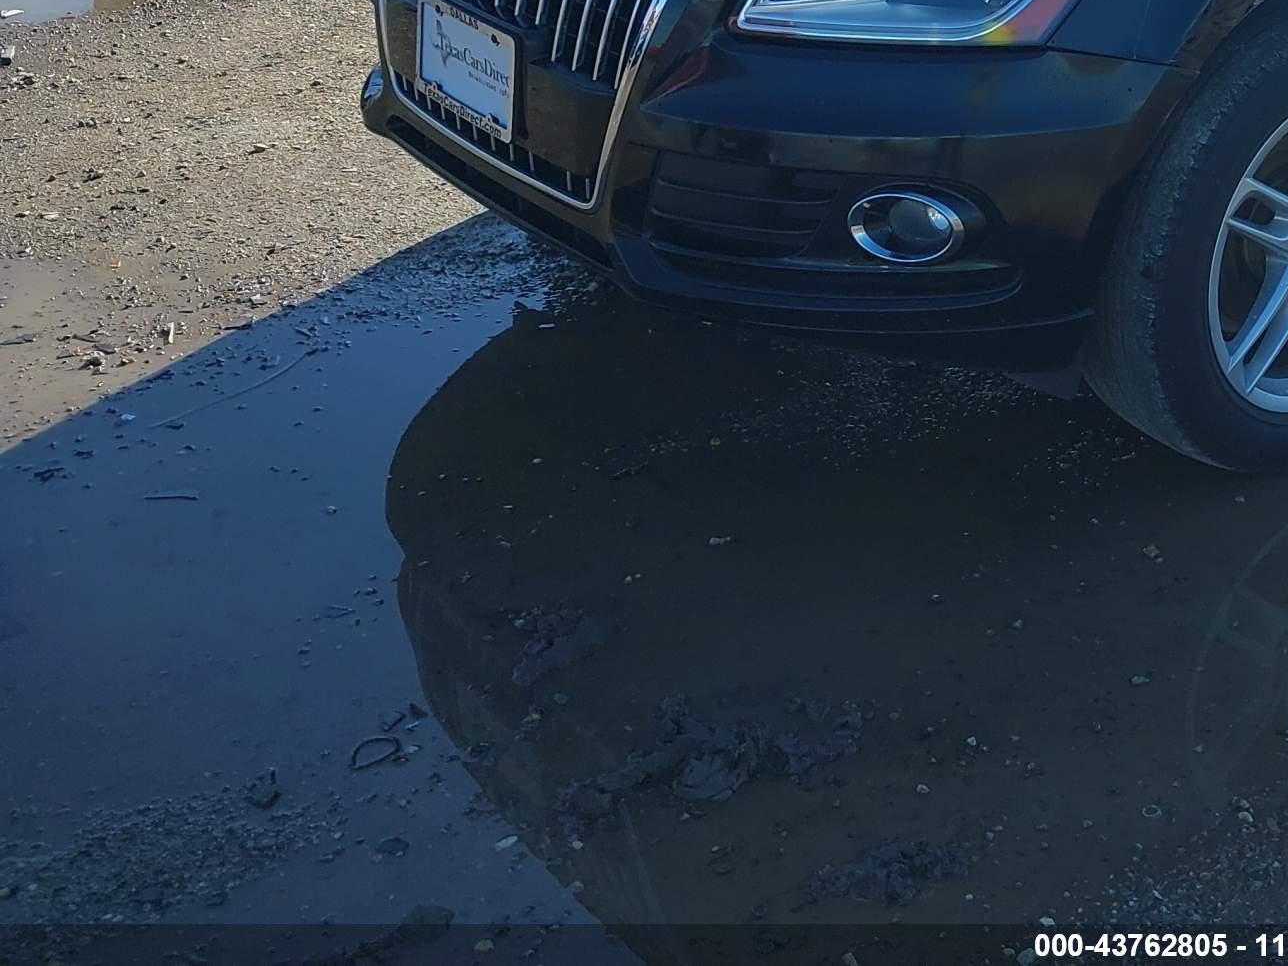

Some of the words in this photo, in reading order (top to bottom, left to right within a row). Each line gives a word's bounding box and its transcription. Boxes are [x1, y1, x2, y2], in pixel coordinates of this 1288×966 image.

[449, 7, 479, 31] DALLAS
[431, 34, 510, 89] TexasCarsDirec
[424, 84, 502, 138] TexasCarsDirect.com
